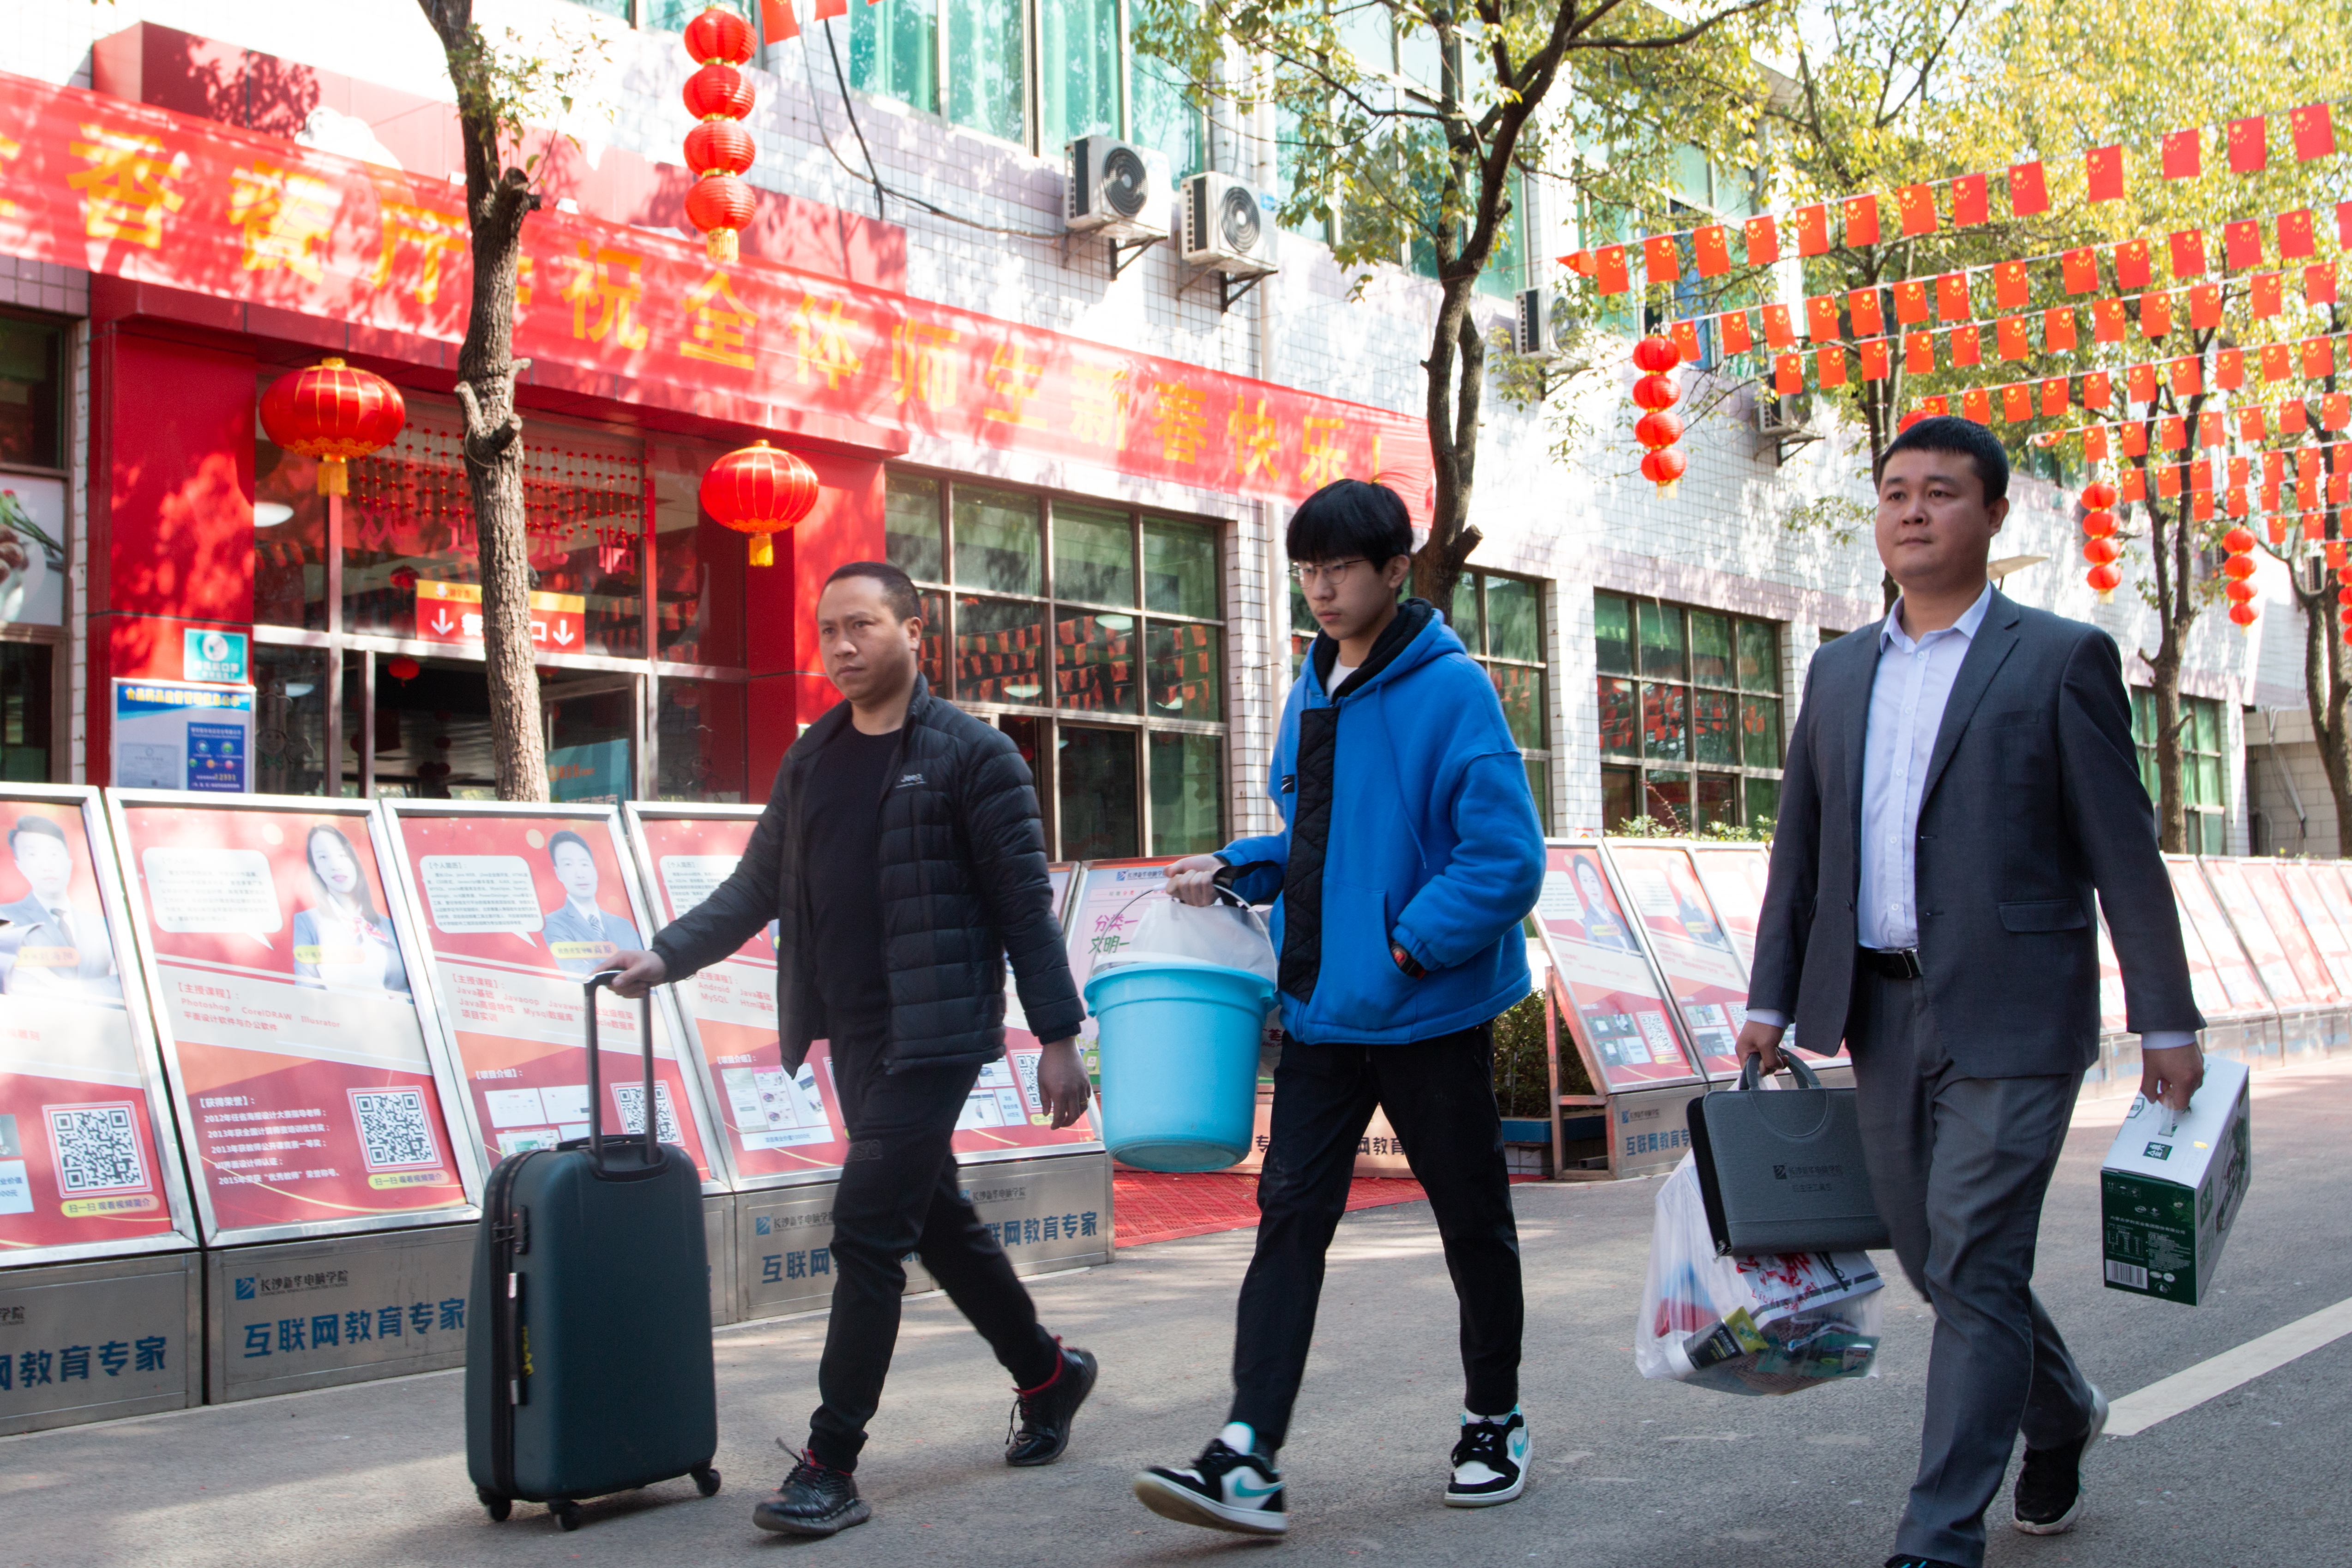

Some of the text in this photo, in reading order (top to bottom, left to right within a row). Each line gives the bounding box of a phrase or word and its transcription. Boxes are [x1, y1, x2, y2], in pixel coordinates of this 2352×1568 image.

[698, 982, 730, 994] Android
[700, 993, 729, 1004] MySQL
[181, 998, 230, 1012] Photoshop
[241, 1007, 292, 1021] CorelDRAW
[1626, 1128, 1690, 1156] 互联网教育专
[984, 1211, 1097, 1247] 联网教育专家
[261, 1270, 348, 1292] 长沙新华电脑学院
[243, 1298, 465, 1358] 互联网教育专家
